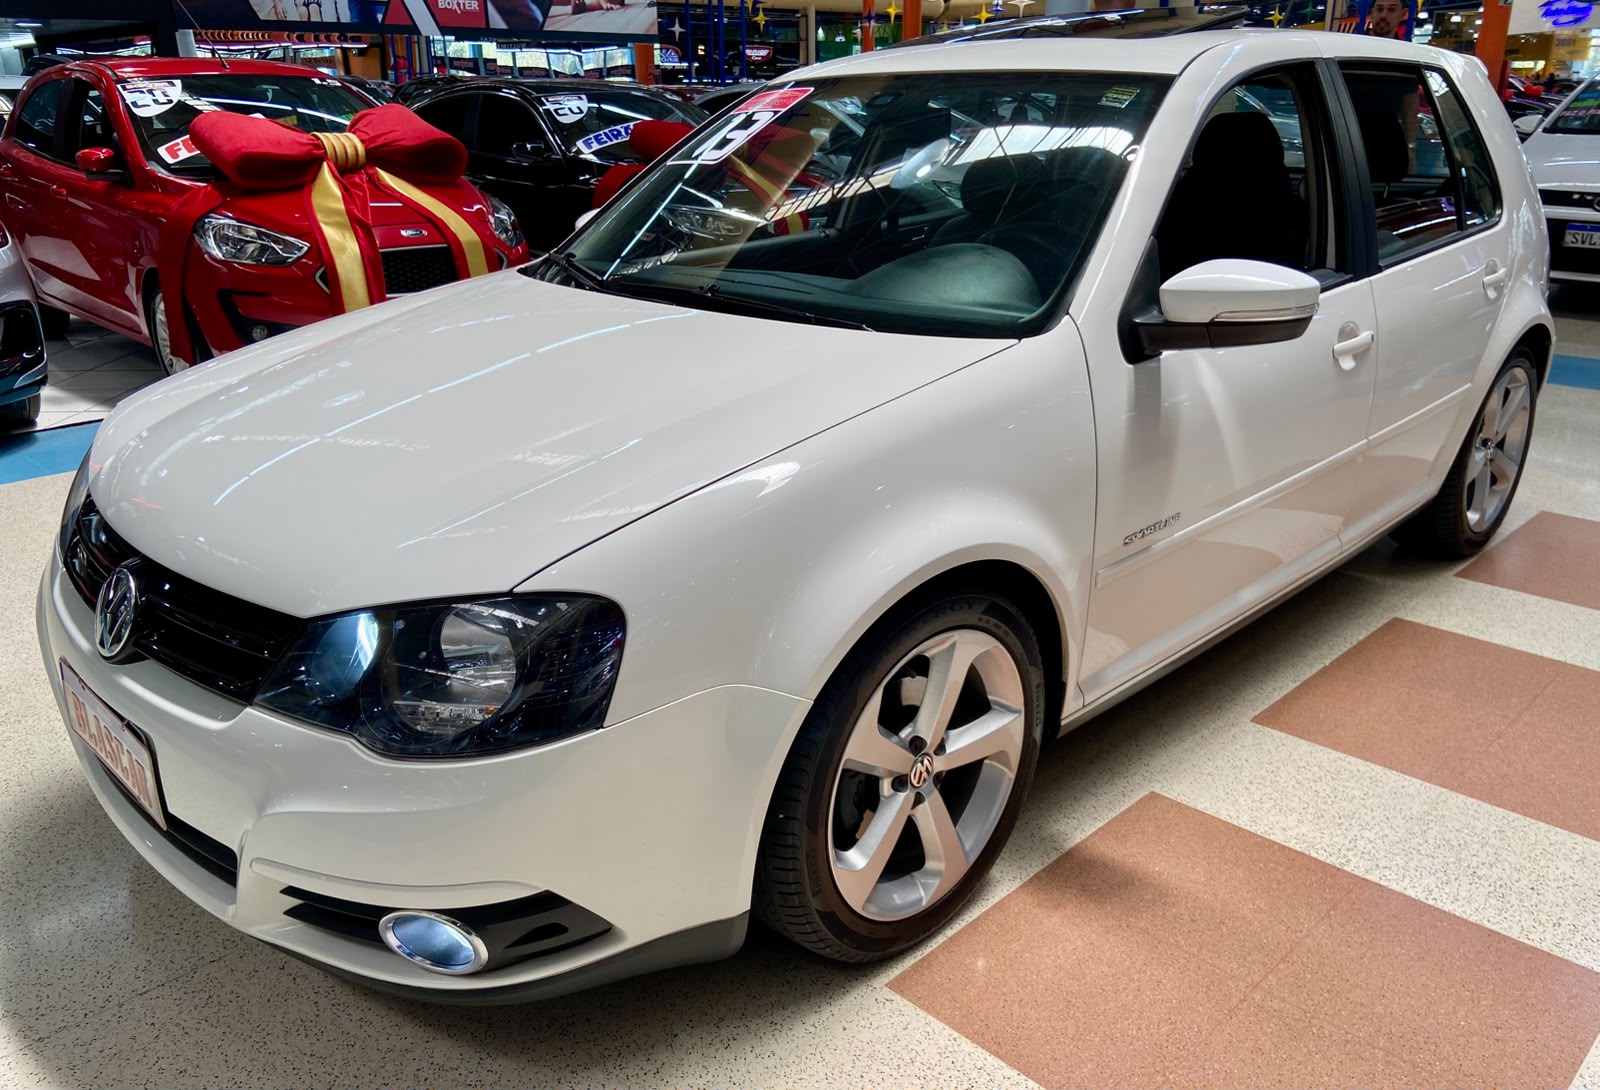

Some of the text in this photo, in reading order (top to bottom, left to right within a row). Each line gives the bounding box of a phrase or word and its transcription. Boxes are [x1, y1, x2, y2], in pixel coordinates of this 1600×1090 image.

[438, 0, 479, 13] BOXTER
[127, 89, 174, 109] 20
[691, 111, 774, 160] 13
[1570, 231, 1600, 246] SVL
[72, 690, 154, 809] BLASCAR
